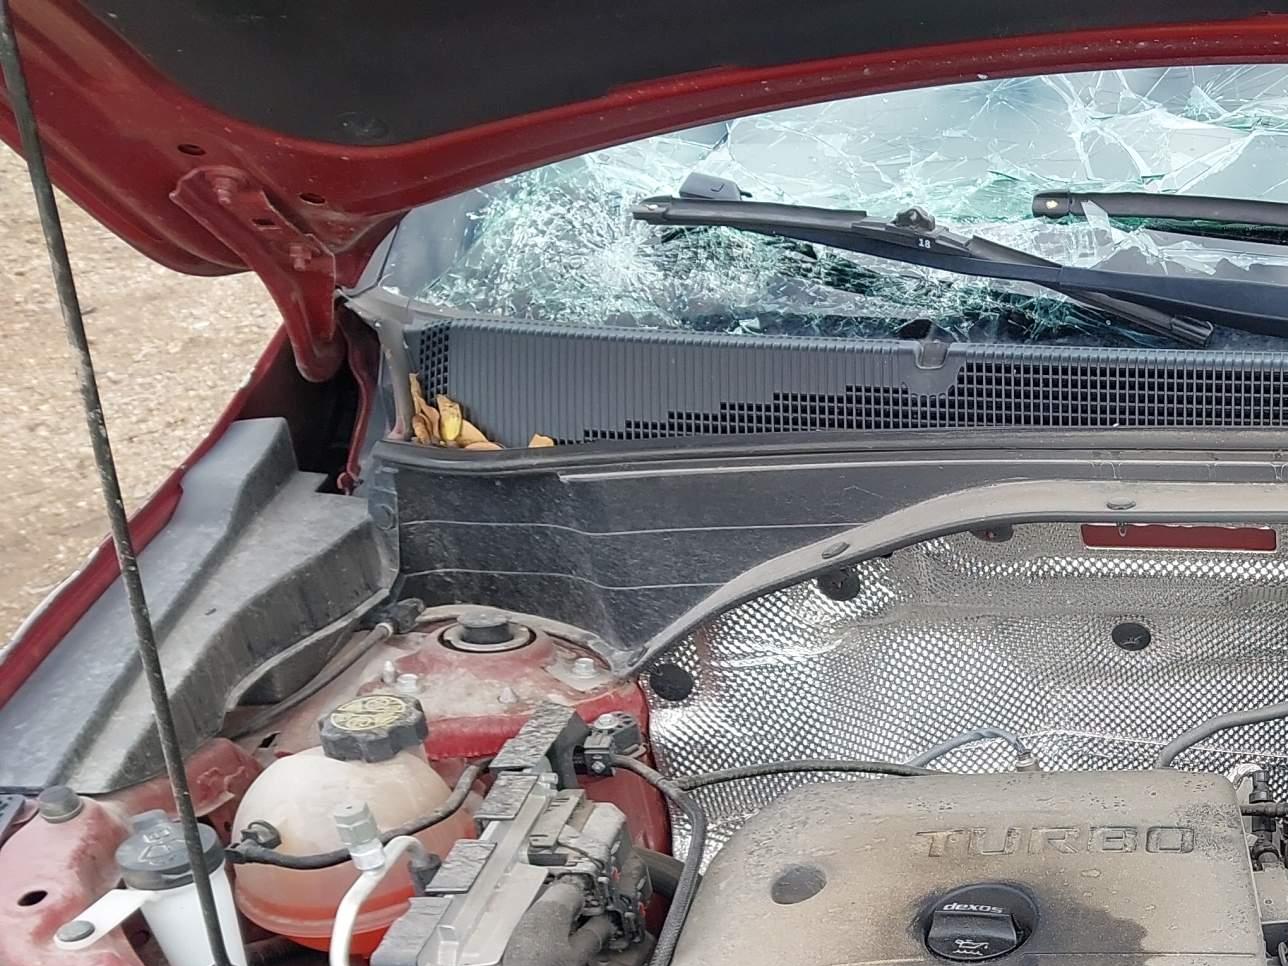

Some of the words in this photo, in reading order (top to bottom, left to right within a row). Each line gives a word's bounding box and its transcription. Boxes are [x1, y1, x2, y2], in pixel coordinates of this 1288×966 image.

[919, 238, 931, 249] 18
[915, 826, 1195, 857] TURBO
[943, 902, 1004, 914] dexos
